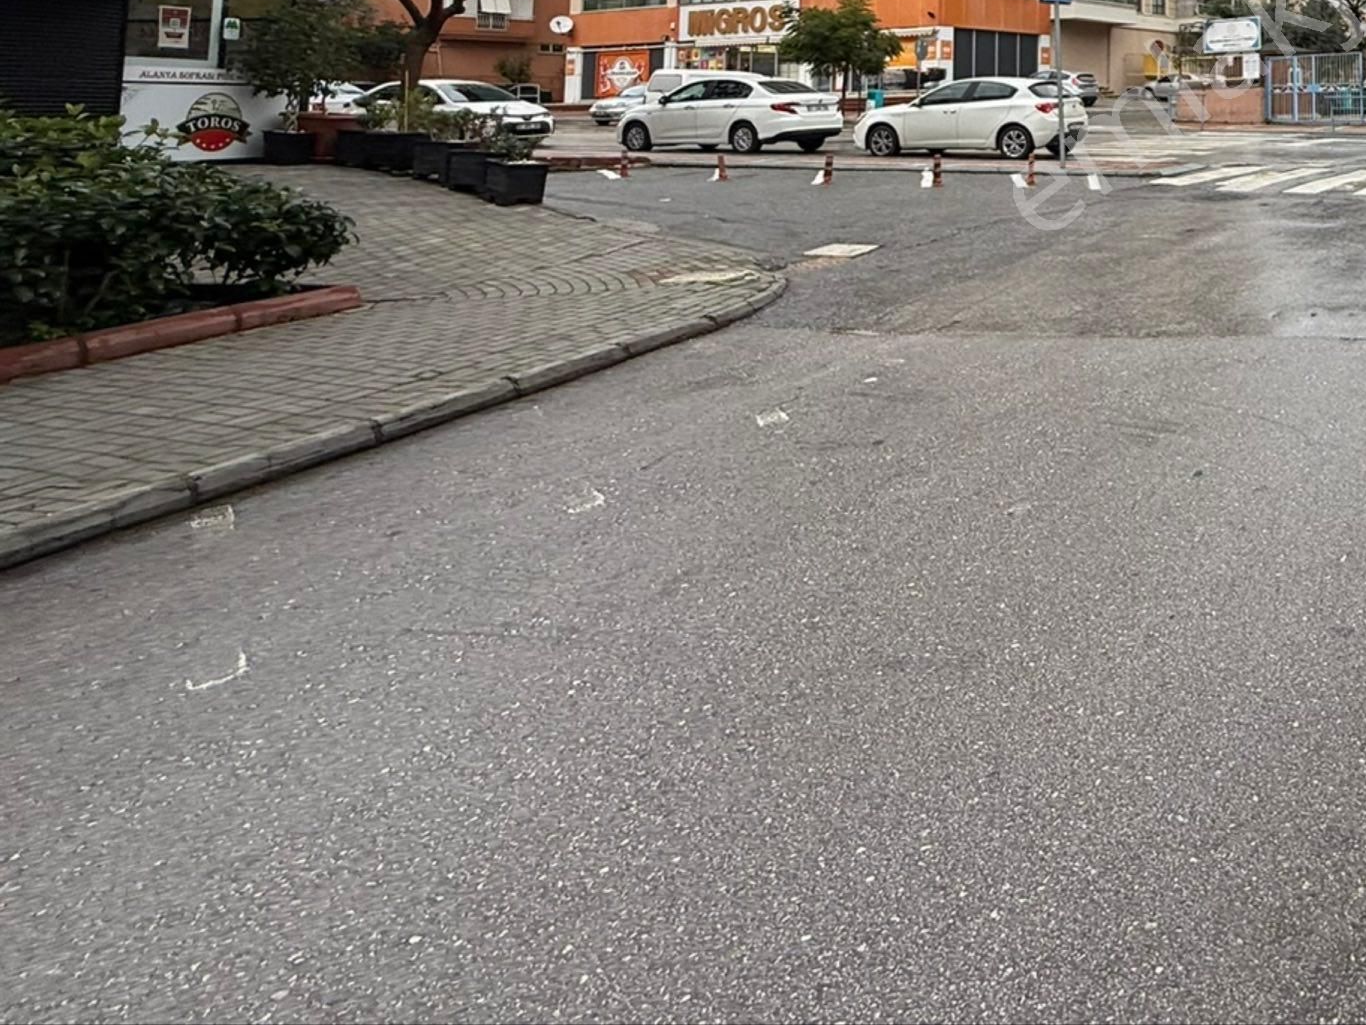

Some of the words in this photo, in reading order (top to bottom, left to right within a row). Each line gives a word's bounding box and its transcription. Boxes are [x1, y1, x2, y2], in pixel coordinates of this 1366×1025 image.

[687, 4, 787, 38] MIGROS
[139, 69, 177, 79] ALANYA
[185, 116, 242, 132] TOROS
